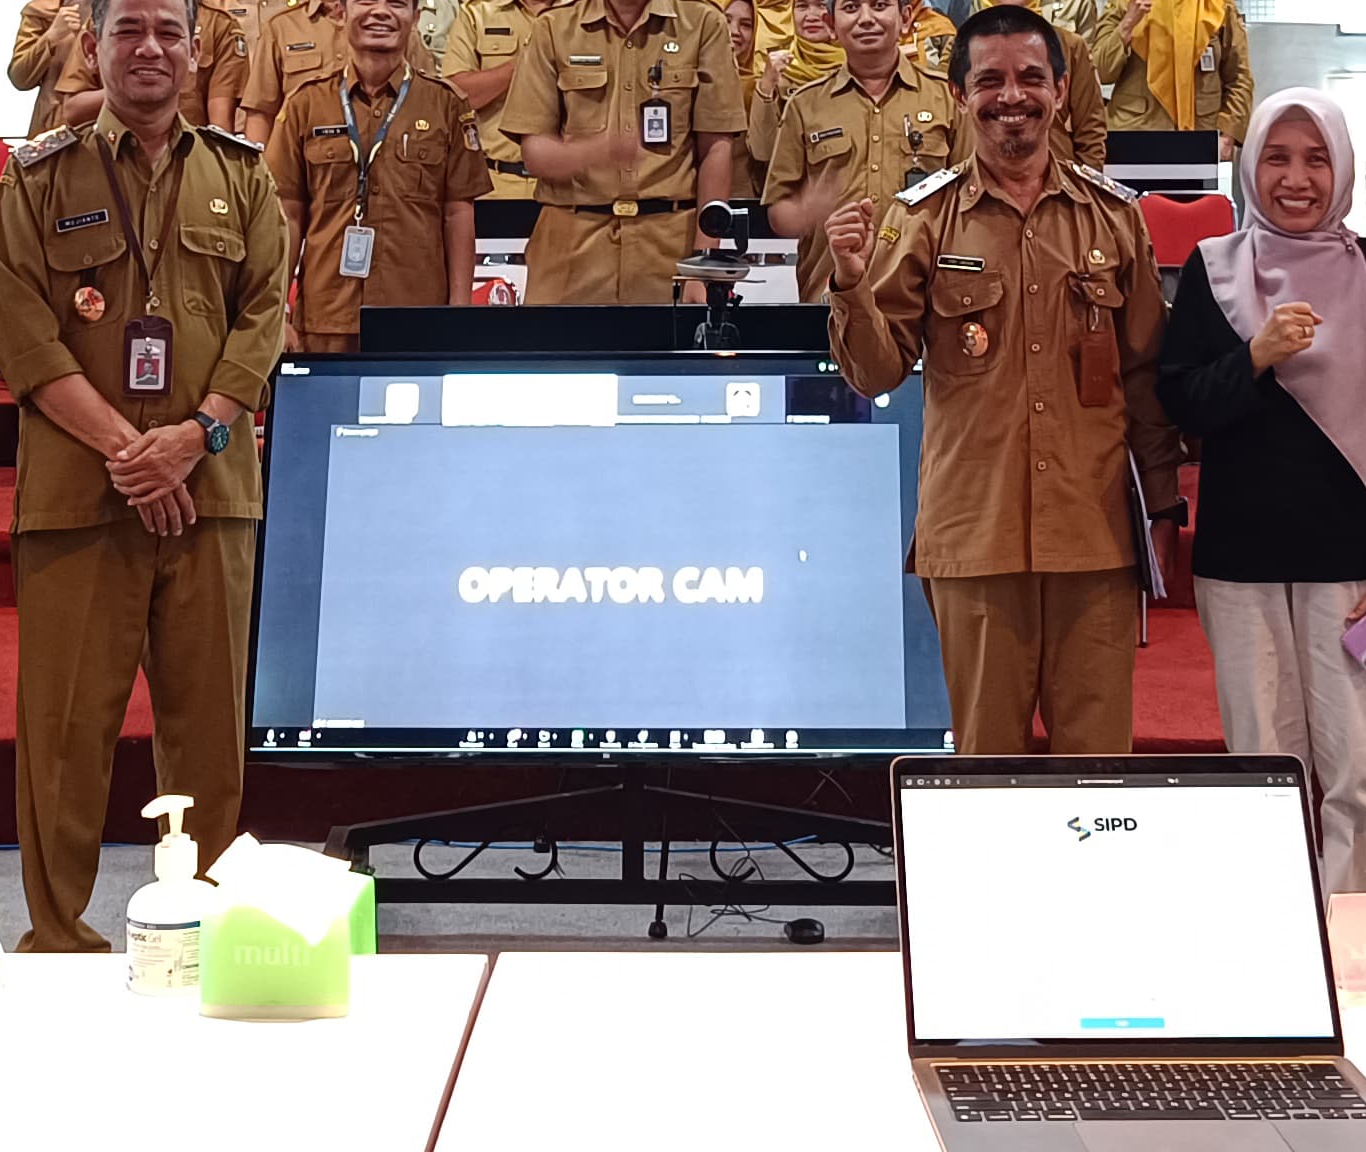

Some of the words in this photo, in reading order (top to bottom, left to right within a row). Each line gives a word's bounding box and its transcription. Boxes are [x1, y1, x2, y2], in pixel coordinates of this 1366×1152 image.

[458, 567, 666, 603] OPERATOR
[672, 567, 764, 603] CAM
[1094, 817, 1138, 832] SIPD
